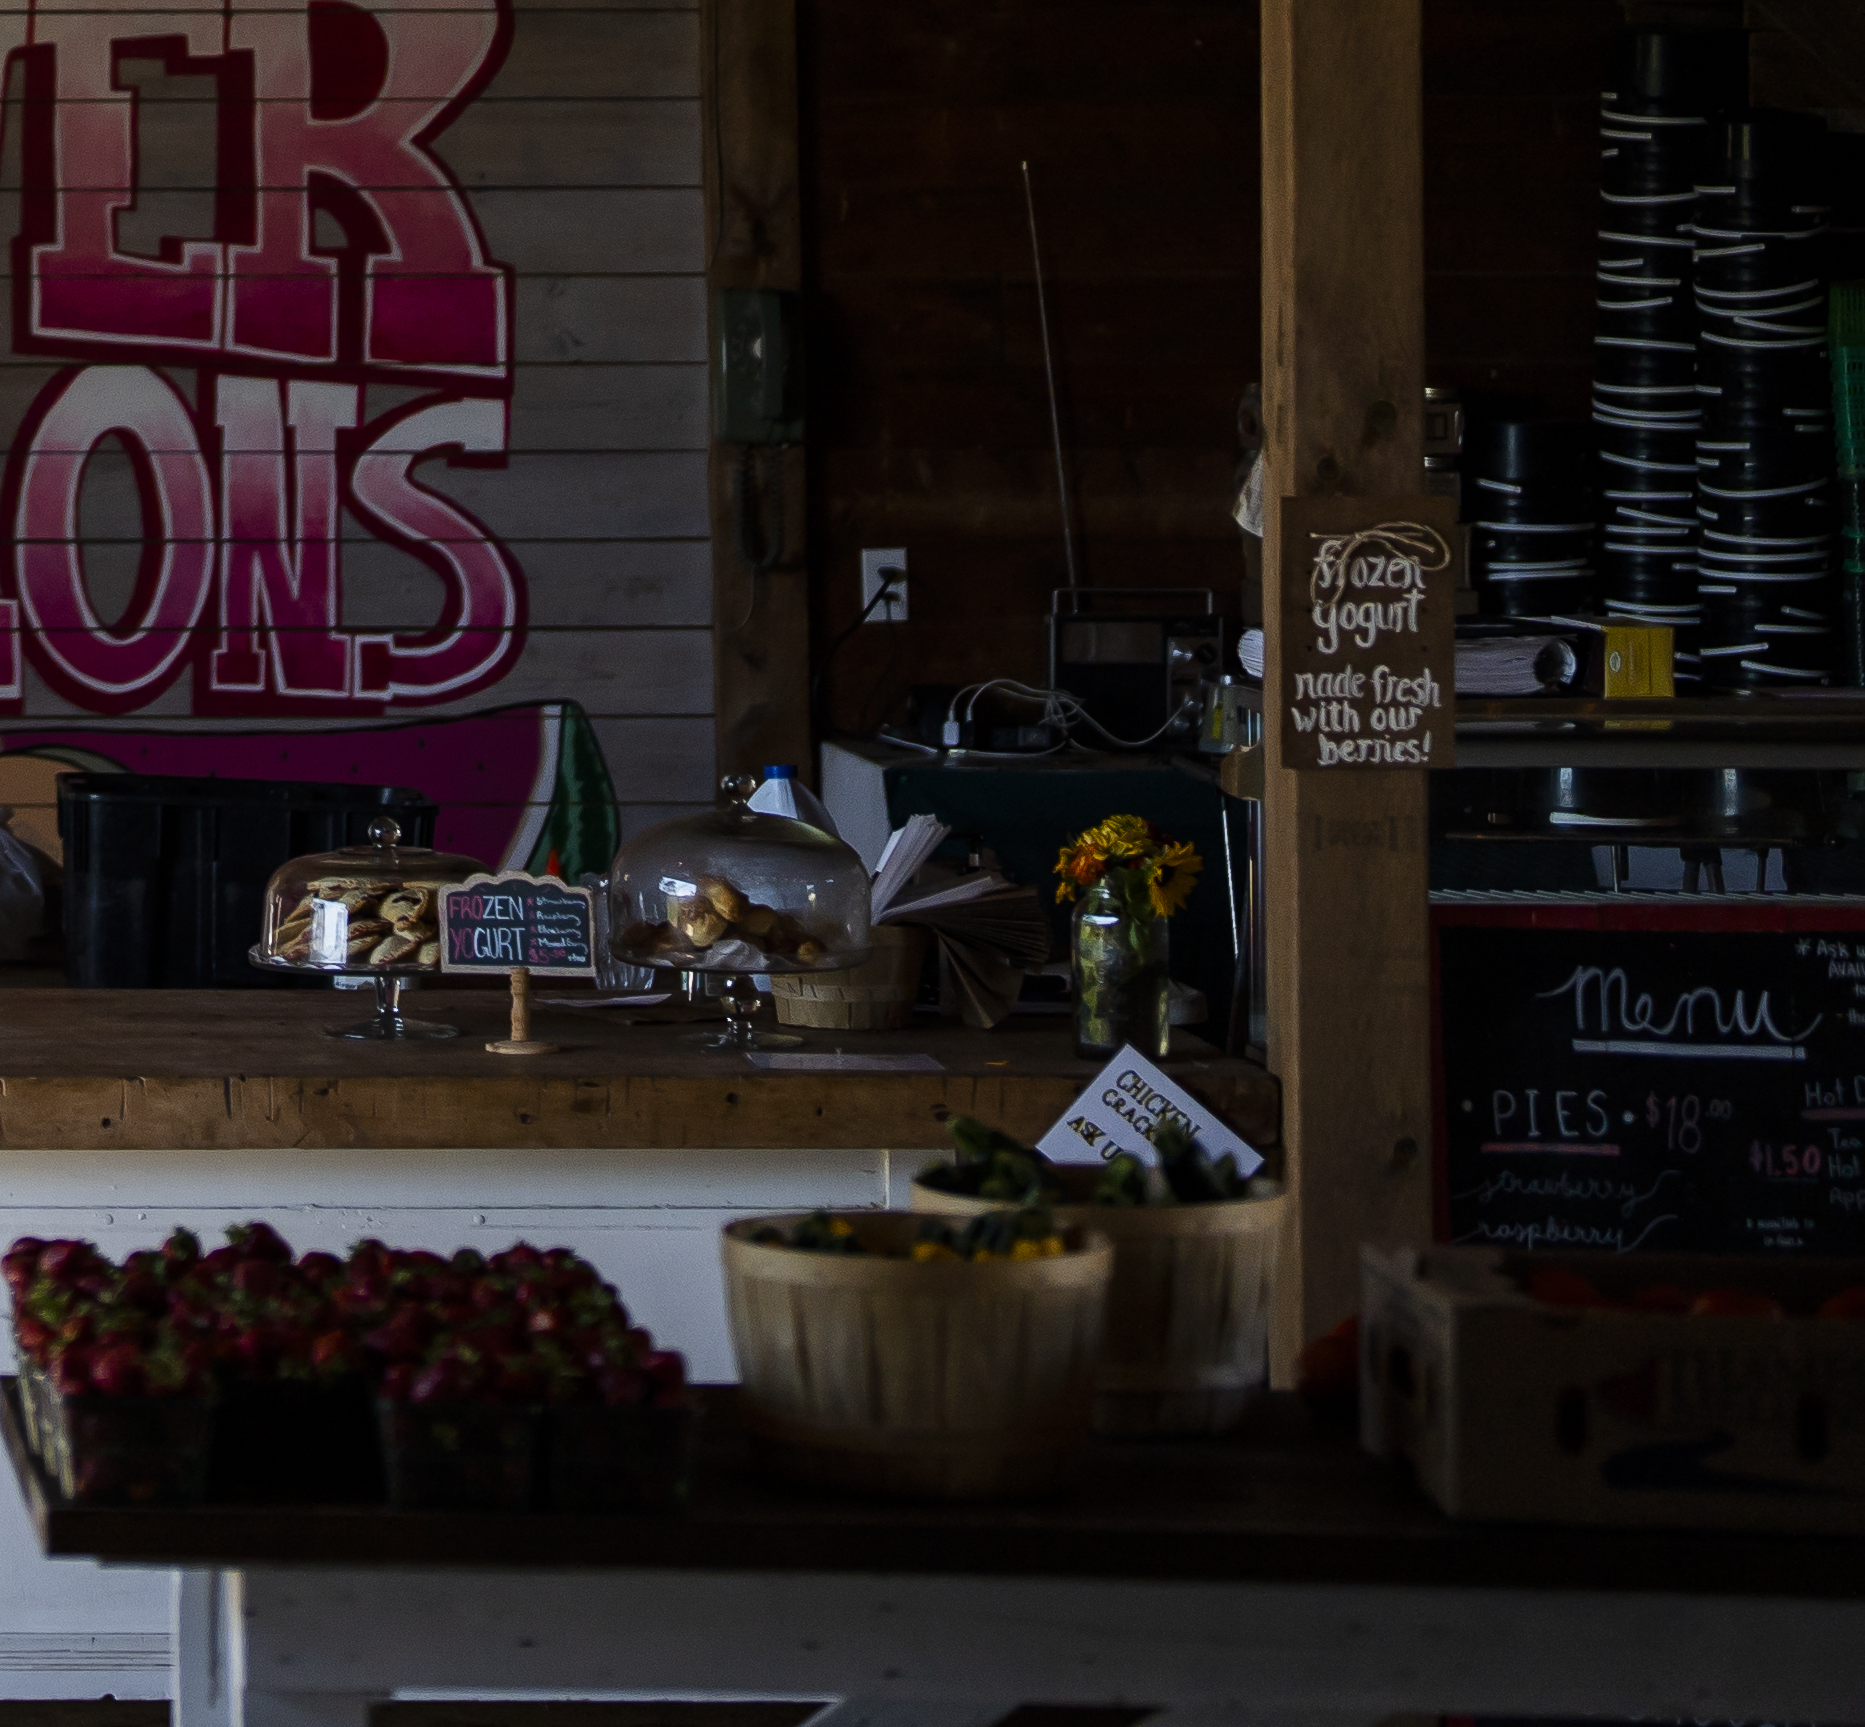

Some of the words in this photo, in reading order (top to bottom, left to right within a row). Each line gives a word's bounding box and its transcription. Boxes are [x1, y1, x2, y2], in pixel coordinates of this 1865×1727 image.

[1312, 588, 1426, 654] yogurt
[1371, 665, 1442, 707] fresh
[1291, 700, 1360, 733] with
[1370, 705, 1424, 732] our
[1317, 730, 1432, 766] berries!
[449, 895, 524, 922] FROZEN
[449, 927, 525, 961] YOGURT
[1817, 937, 1850, 960] Ask
[1116, 1069, 1203, 1139] CHICKEN
[1804, 1077, 1844, 1109] Hot
[1492, 1089, 1609, 1138] PIES
[1066, 1115, 1107, 1147] ASK
[1100, 1139, 1123, 1160] U
[1749, 1139, 1821, 1176] $1.50
[1828, 1153, 1860, 1178] Hot
[1466, 1214, 1668, 1256] raspberry
